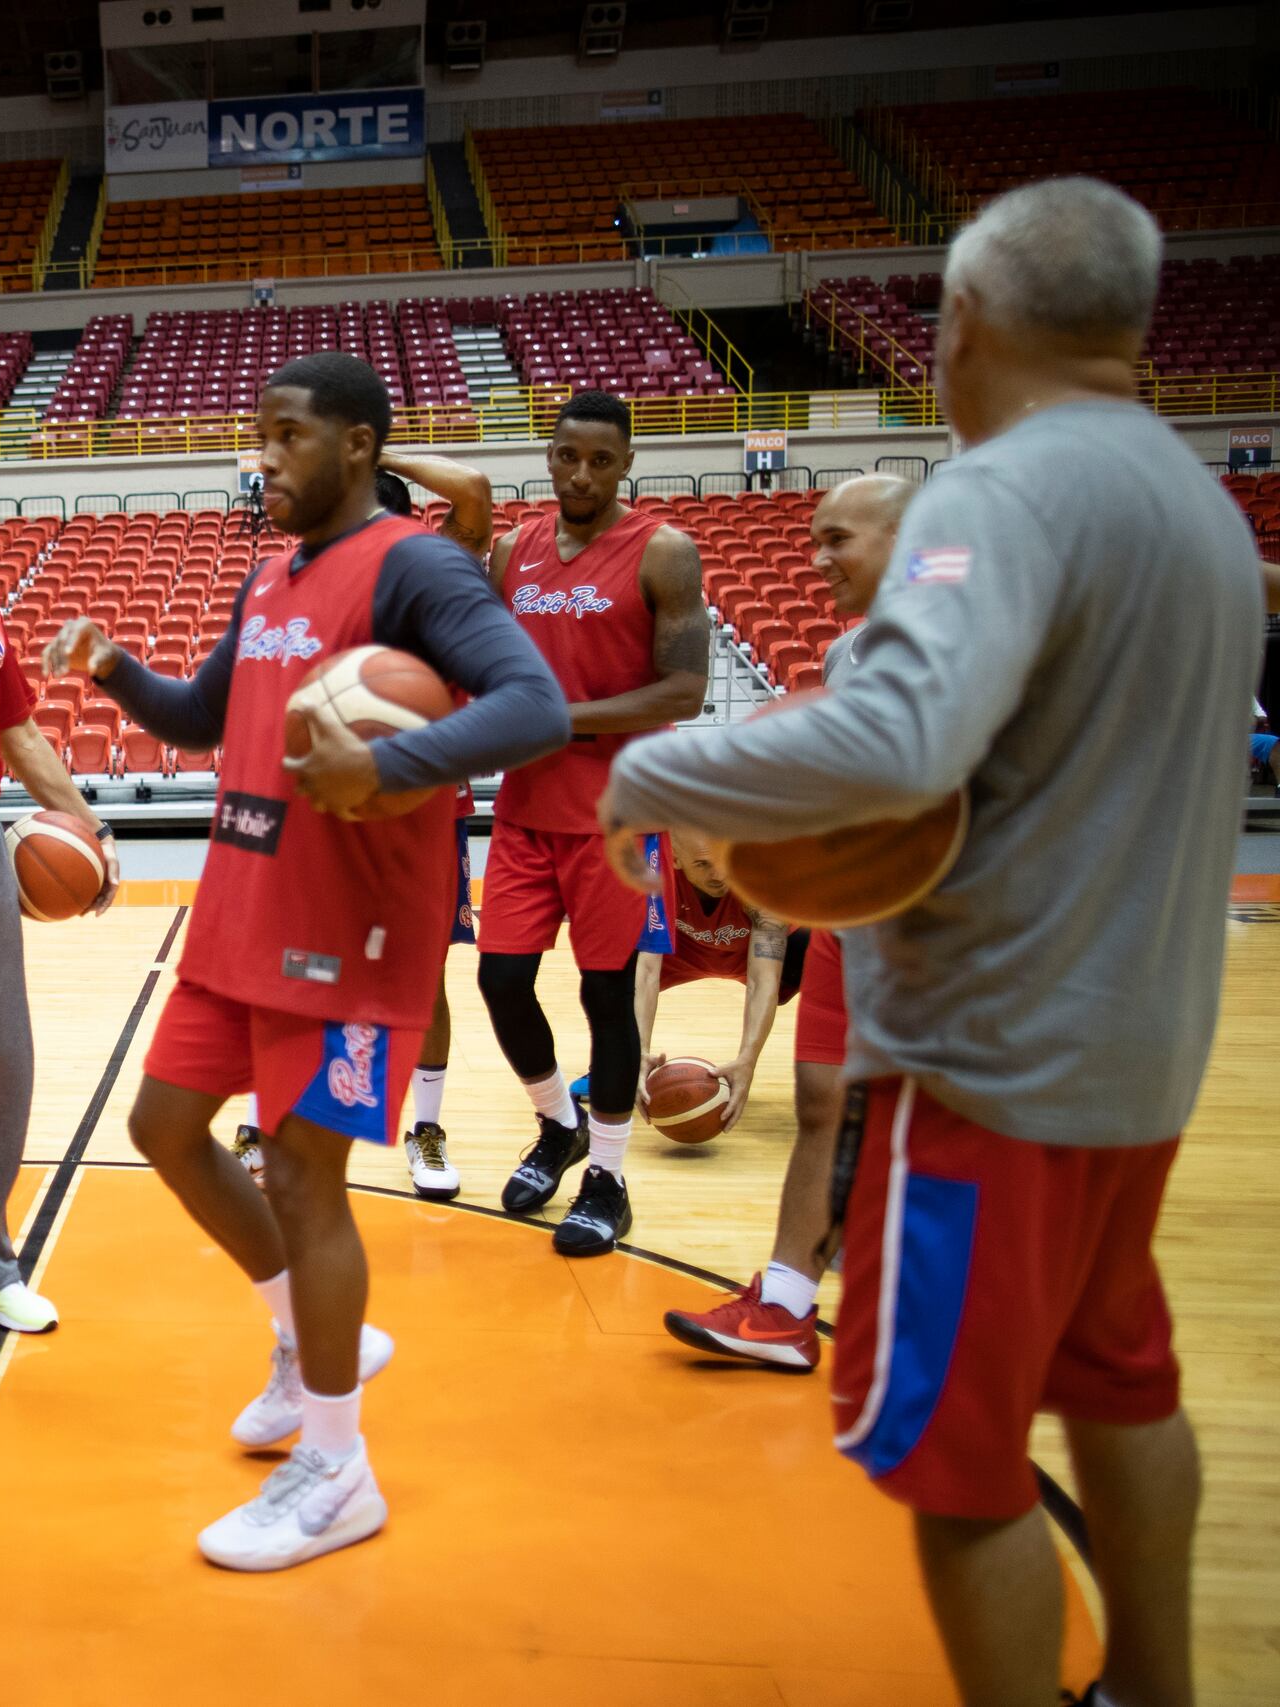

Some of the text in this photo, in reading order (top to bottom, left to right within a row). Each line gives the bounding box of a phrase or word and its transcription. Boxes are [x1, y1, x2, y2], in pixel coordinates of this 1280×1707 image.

[221, 104, 410, 152] NORTE
[747, 436, 784, 448] PALCO
[1232, 434, 1271, 444] PALCO
[757, 451, 772, 470] H
[1245, 449, 1255, 462] 1
[512, 584, 612, 619] Puerto Rico
